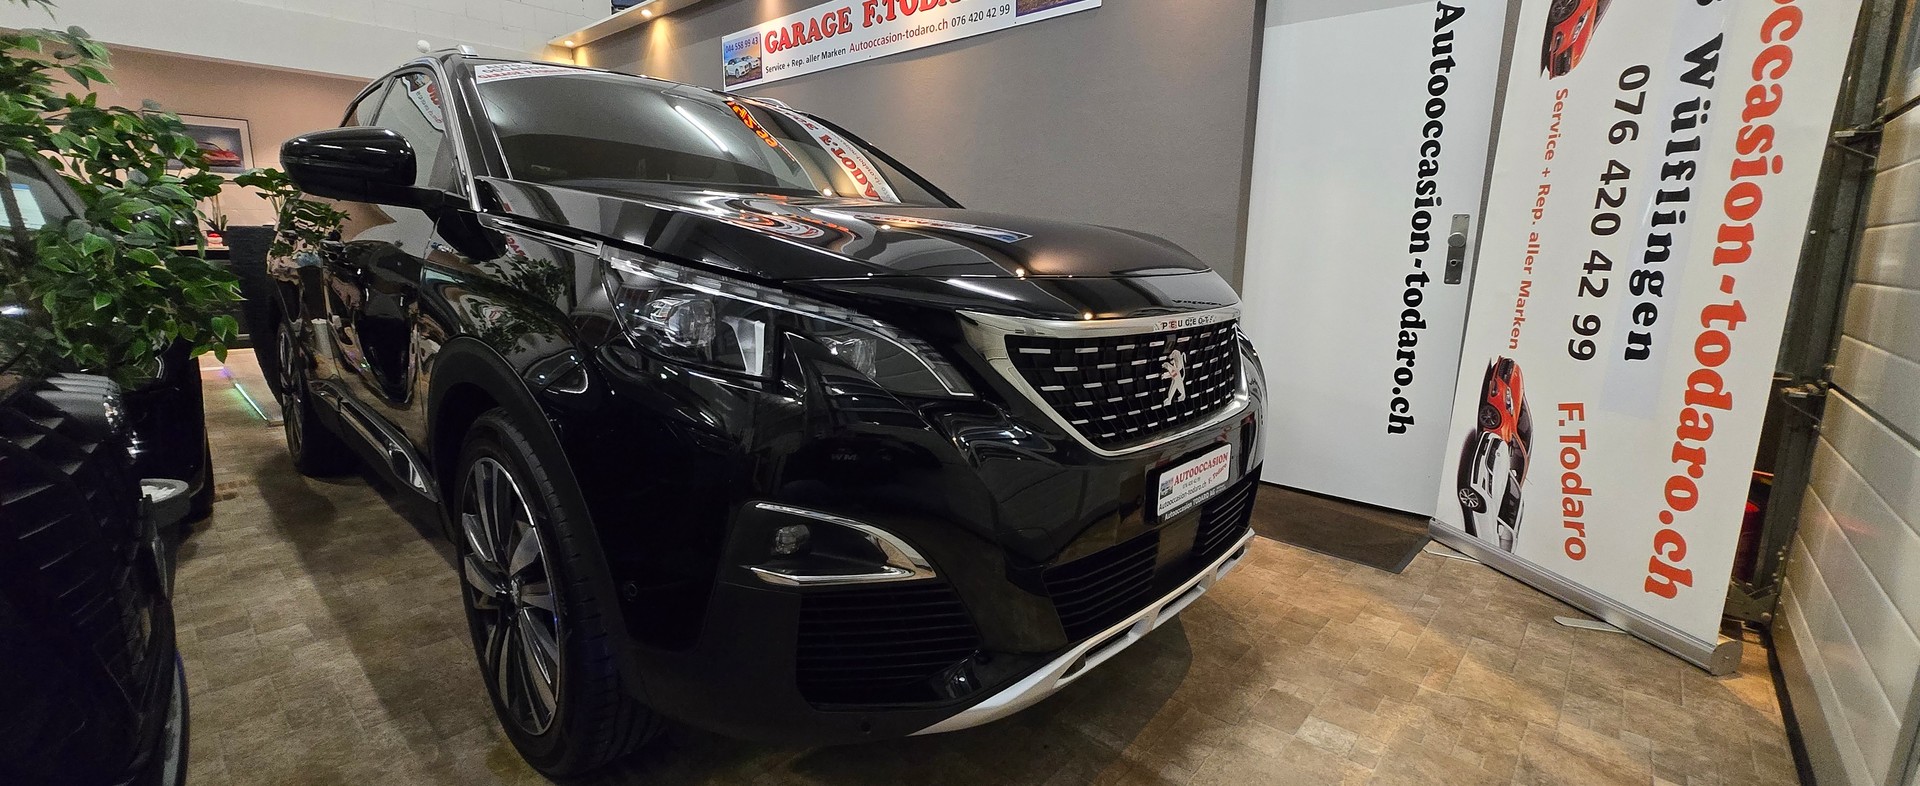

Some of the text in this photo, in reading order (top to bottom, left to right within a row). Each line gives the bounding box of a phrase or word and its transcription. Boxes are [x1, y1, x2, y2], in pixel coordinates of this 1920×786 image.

[725, 36, 758, 54] 044 558 99 43
[764, 7, 853, 53] GARAGE
[765, 63, 785, 74] Service
[791, 58, 805, 68] Rep.
[806, 54, 820, 64] aller
[821, 47, 847, 60] Marken
[849, 18, 949, 53] Autooccasion-todaro.ch
[951, 15, 966, 28] 076
[968, 10, 984, 23] 420
[986, 7, 997, 19] 42
[1000, 4, 1010, 16] 99
[1544, 88, 1569, 161] Service
[1387, 0, 1466, 435] Autooccasion-todaro.ch
[1531, 184, 1551, 225] Rep.
[1568, 64, 1651, 361] 076 420 42 99
[1624, 32, 1724, 361] Wülflingen
[1523, 231, 1541, 275] aller
[1508, 280, 1532, 350] Marken
[1644, 0, 1804, 600] ccasion-todaro.ch
[1173, 452, 1229, 486] AUTOOCCASION
[1558, 402, 1592, 561] F.Todaro
